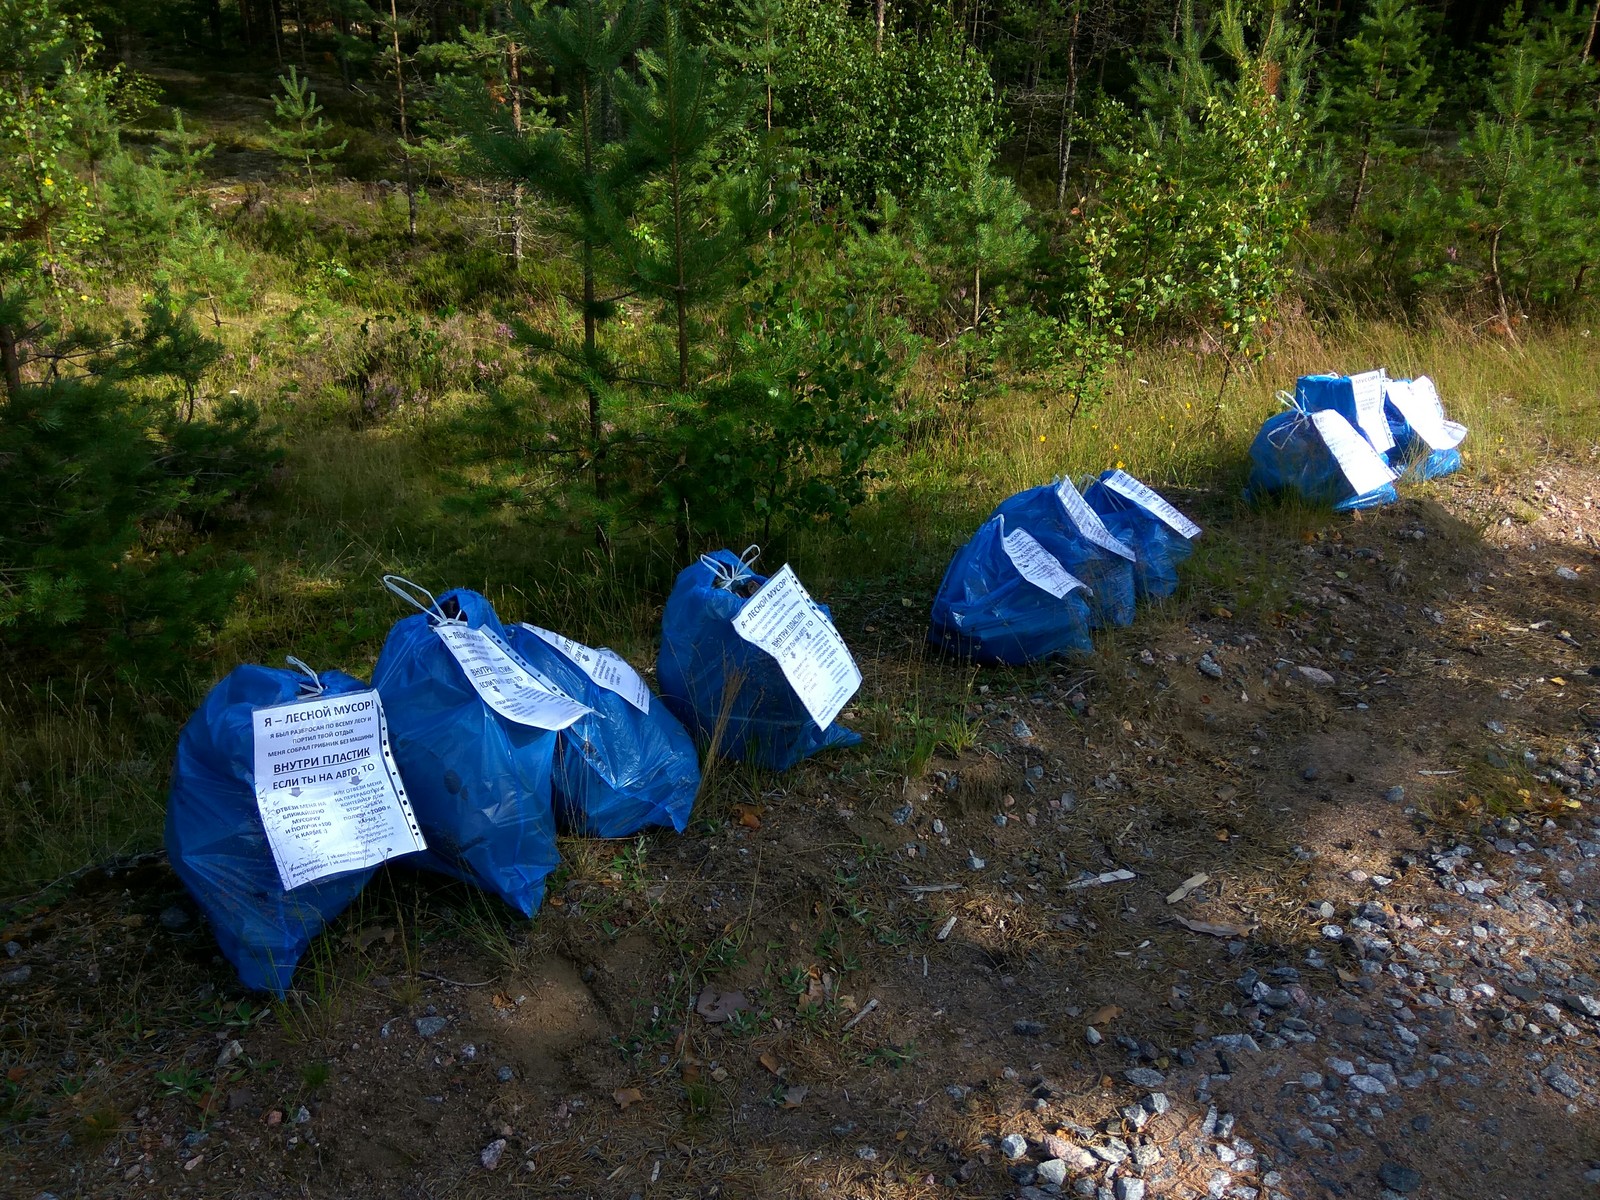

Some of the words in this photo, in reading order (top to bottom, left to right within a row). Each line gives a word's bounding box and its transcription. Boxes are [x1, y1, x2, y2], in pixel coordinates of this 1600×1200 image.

[741, 621, 747, 629] Я
[747, 595, 769, 621] ЛЕСНОЙ
[767, 576, 789, 600] МУСОР!
[772, 627, 790, 648] ВНУТРИ
[787, 610, 806, 634] ПЛАСТИК
[805, 620, 814, 630] ТО
[264, 717, 272, 727] Я
[285, 706, 330, 724] ЛЕСНОЙ
[334, 700, 374, 716] МУСОР!
[290, 725, 324, 736] РАЗБРОСАН
[335, 719, 354, 727] ВСЕМУ
[267, 749, 286, 757] МЕНЯ
[286, 744, 310, 754] СОБРАЛ
[311, 741, 339, 750] ГРИБНИК
[350, 733, 374, 743] МАШИНЫ
[292, 735, 316, 744] ПОРТИЛ
[317, 731, 333, 740] ТВОЙ
[334, 729, 354, 737] ОТДЫХ
[274, 757, 319, 773] ВНУТРИ
[323, 747, 370, 765] ПЛАСТИК
[273, 778, 299, 790] ЕСЛИ
[301, 775, 316, 785] ТЫ
[319, 772, 333, 782] НА
[336, 767, 360, 779] АВТО,
[361, 763, 375, 772] ТО
[346, 784, 366, 793] ОТВЕЗИ
[276, 805, 299, 814] ОТВЕЗИ
[282, 808, 325, 819] БЛИЖАЙШУЮ
[292, 816, 320, 824] МУСОРКУ
